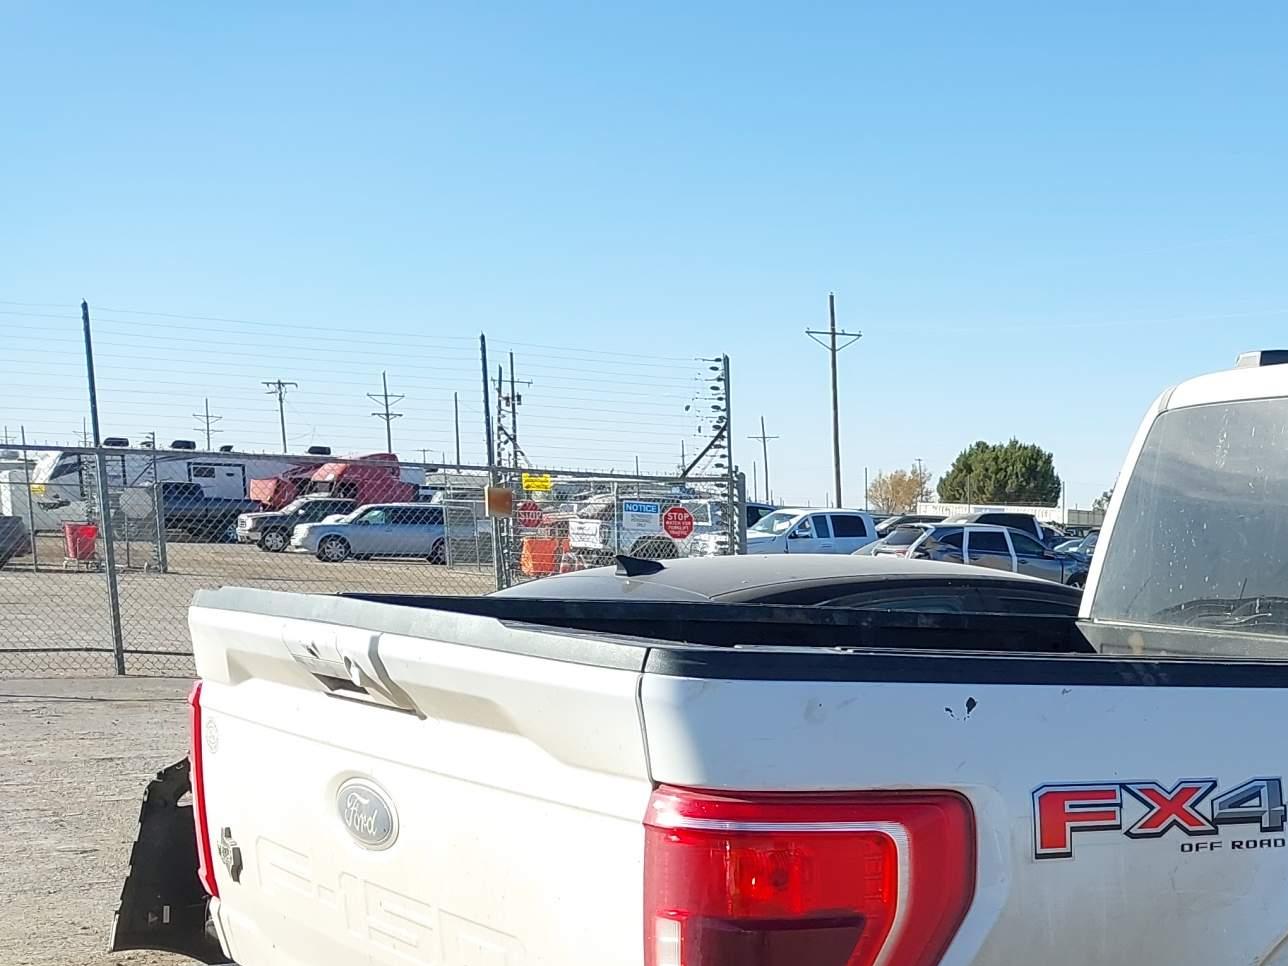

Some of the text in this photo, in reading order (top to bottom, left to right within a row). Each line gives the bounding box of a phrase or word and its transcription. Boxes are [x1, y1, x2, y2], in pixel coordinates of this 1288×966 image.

[625, 503, 657, 513] NOTICE
[519, 510, 542, 519] STOP
[667, 512, 690, 521] STOP
[1031, 776, 1288, 861] FX4
[1180, 837, 1286, 853] OFF ROAD
